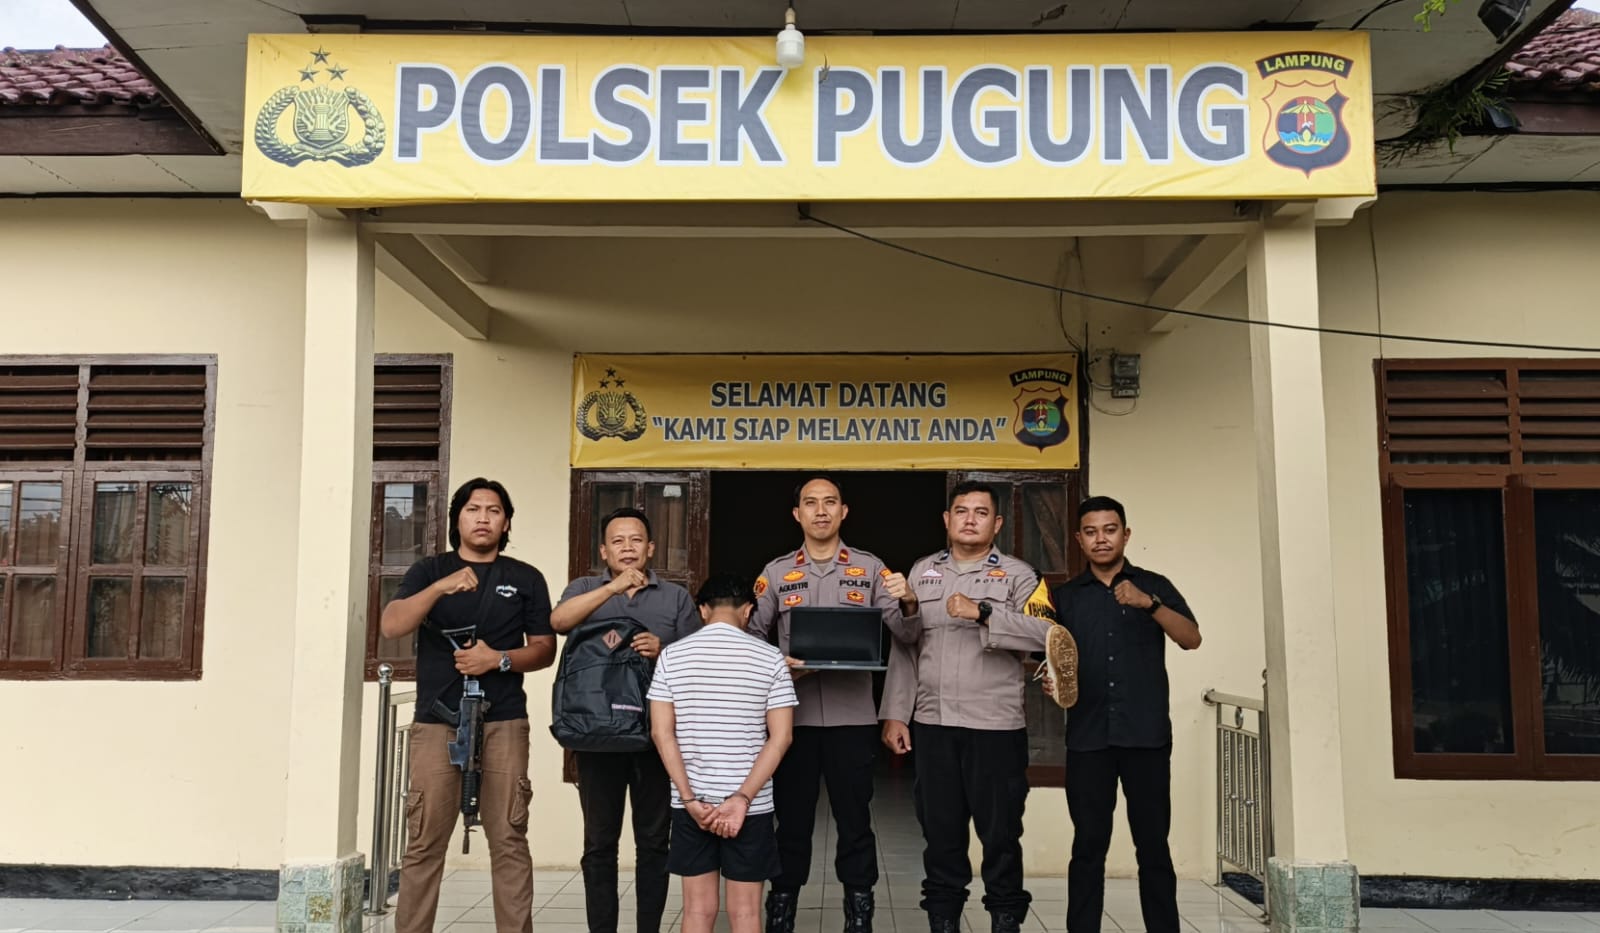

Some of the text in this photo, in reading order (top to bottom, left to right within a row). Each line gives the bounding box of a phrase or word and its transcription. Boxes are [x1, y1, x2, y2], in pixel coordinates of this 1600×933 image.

[1263, 54, 1347, 73] LAMPUNG
[396, 63, 1247, 166] POLSEK PUGUNG
[1014, 369, 1068, 384] LAMPUNG
[711, 381, 947, 408] SELAMAT DATANG
[733, 417, 791, 442] SIAP
[797, 417, 922, 442] MELAYANI
[839, 579, 871, 589] POLRI
